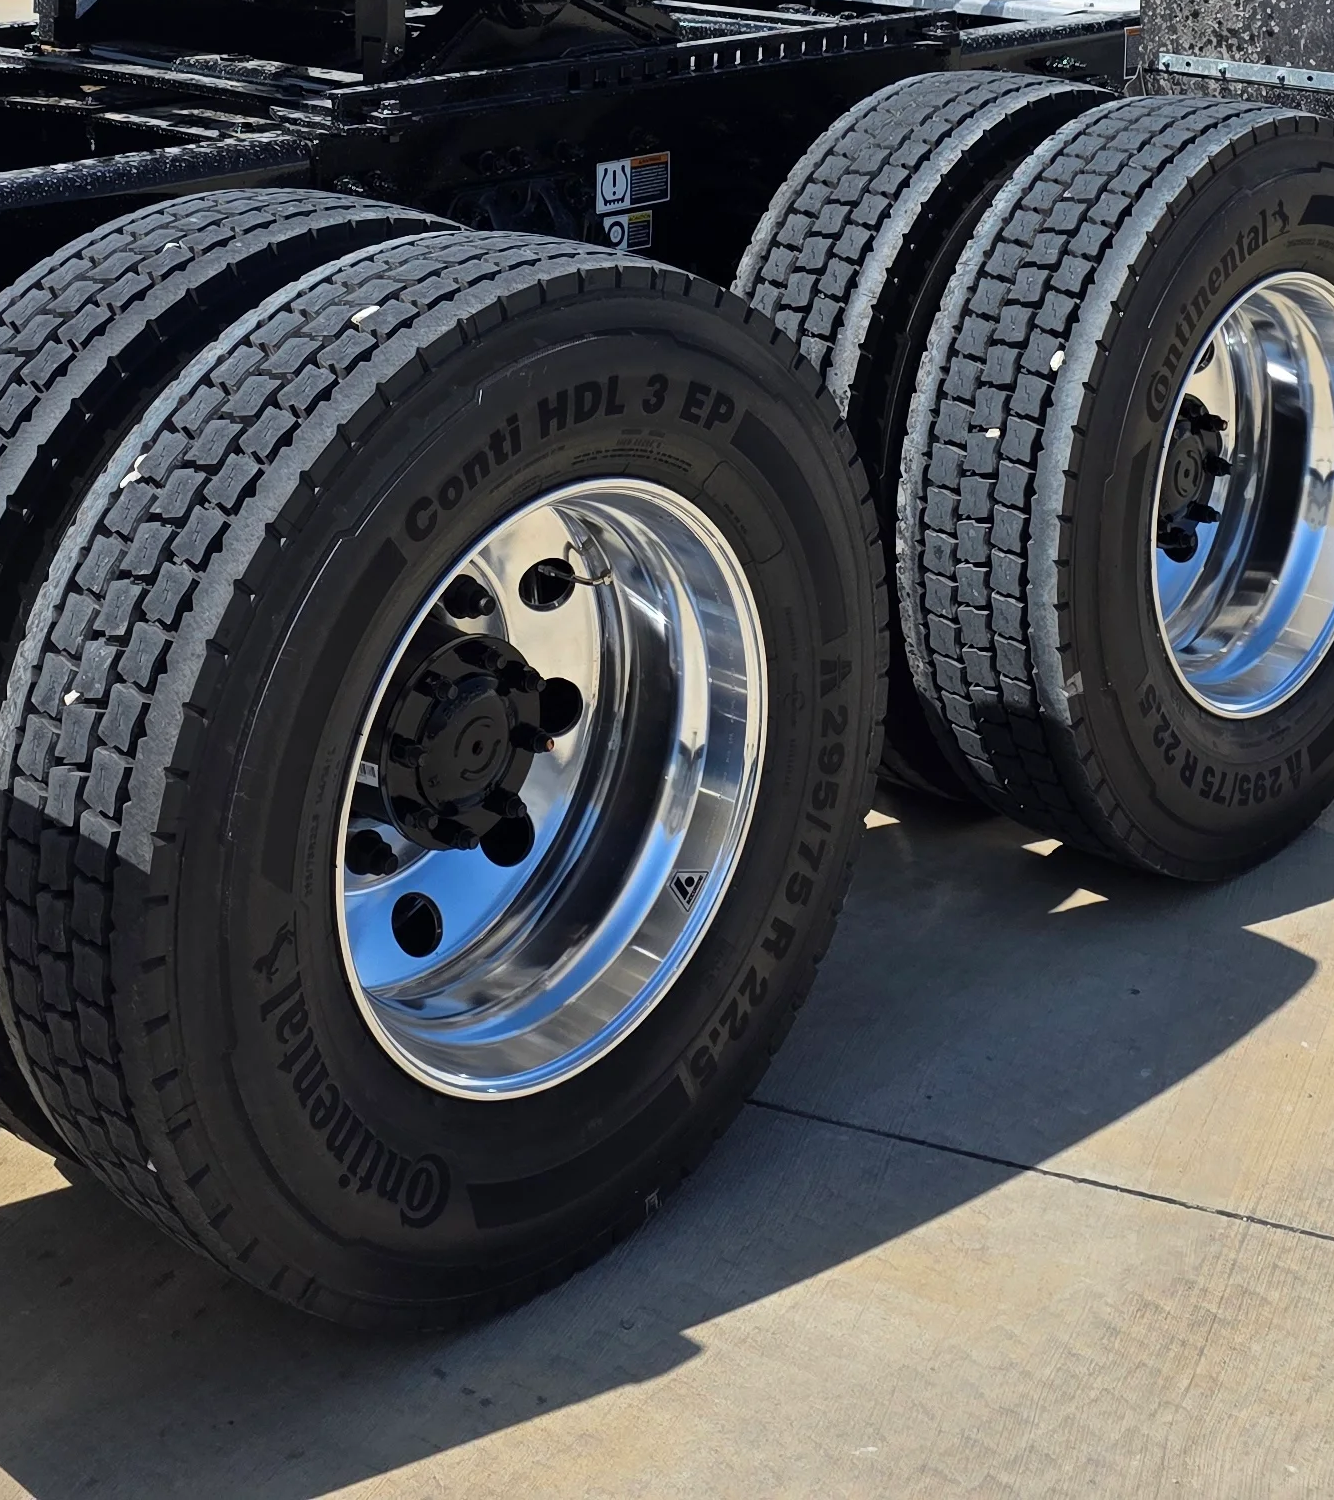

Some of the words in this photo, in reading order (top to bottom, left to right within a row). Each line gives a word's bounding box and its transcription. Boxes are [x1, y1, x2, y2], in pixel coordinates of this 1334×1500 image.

[1146, 210, 1269, 423] Continental
[404, 414, 523, 542] Conti
[537, 375, 626, 440] HDL
[641, 373, 668, 415] 3
[679, 380, 735, 431] EP
[1138, 683, 1182, 766] 22.5
[1179, 747, 1199, 790] R
[1199, 765, 1283, 808] 295/75
[783, 703, 849, 909] 295/75
[760, 915, 797, 962] R
[689, 964, 768, 1090] 22.5
[260, 971, 451, 1230] Continental
